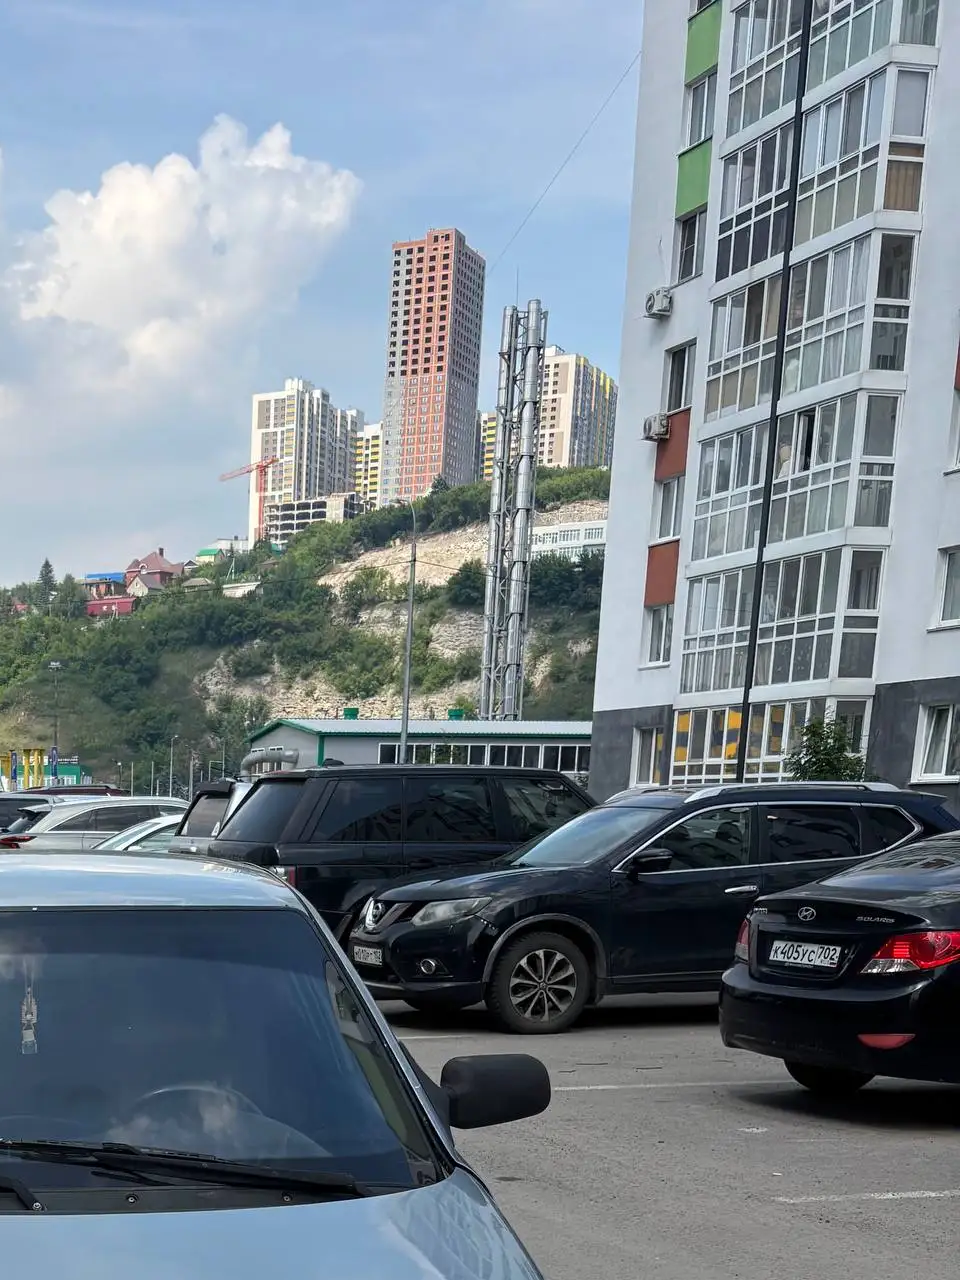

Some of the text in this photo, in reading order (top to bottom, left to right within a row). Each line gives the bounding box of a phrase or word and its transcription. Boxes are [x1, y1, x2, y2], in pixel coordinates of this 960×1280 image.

[856, 915, 895, 924] SOLARIS
[773, 943, 837, 962] К405УС 702
